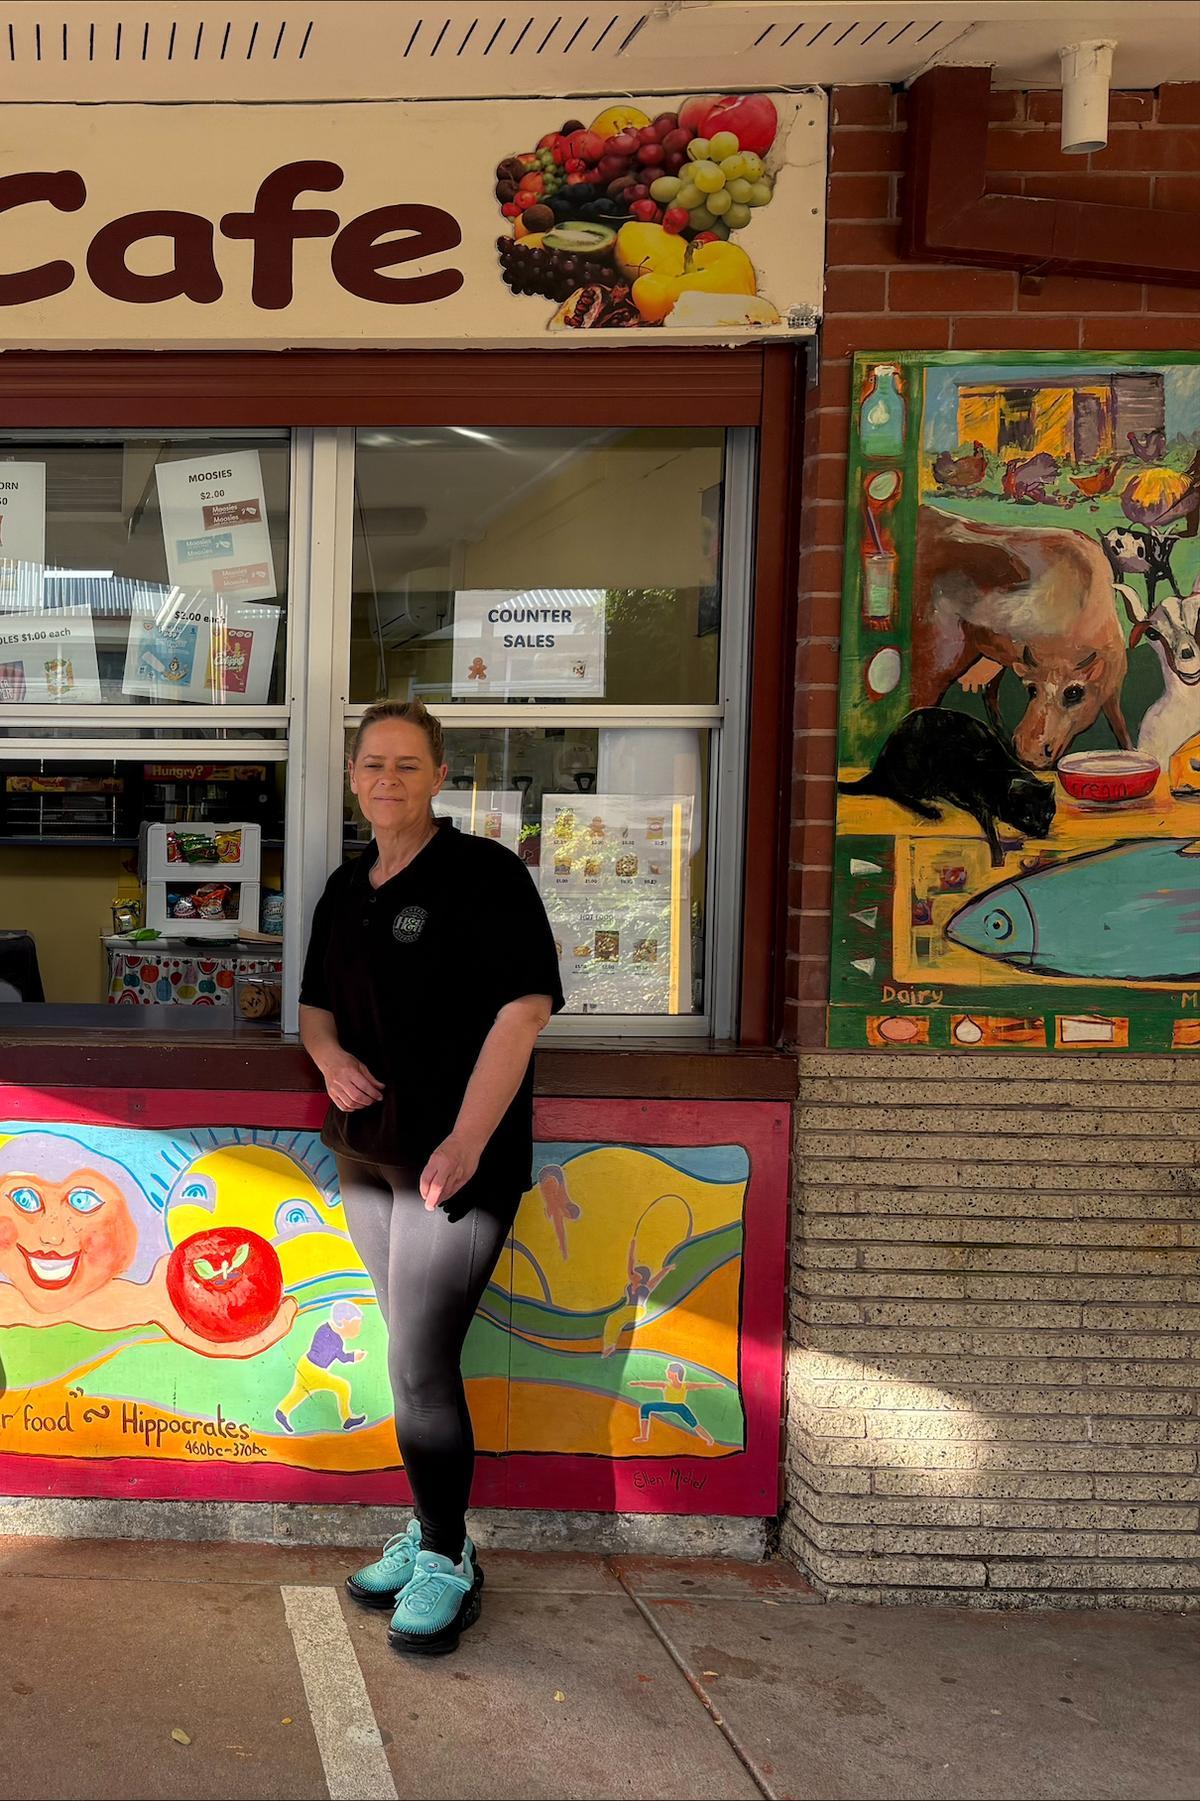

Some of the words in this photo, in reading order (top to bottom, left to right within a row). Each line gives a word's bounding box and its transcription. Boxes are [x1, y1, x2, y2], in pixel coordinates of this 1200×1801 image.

[188, 469, 232, 483] MOOSIES
[200, 489, 225, 500] $2.00
[488, 609, 572, 623] COUNTER
[21, 631, 47, 642] $1.00
[48, 627, 71, 638] each
[503, 635, 555, 648] SALES
[153, 766, 204, 779] Hungry?
[880, 986, 944, 1006] Dairy
[122, 1403, 251, 1448] Hippocrates
[633, 1471, 665, 1489] Ellen
